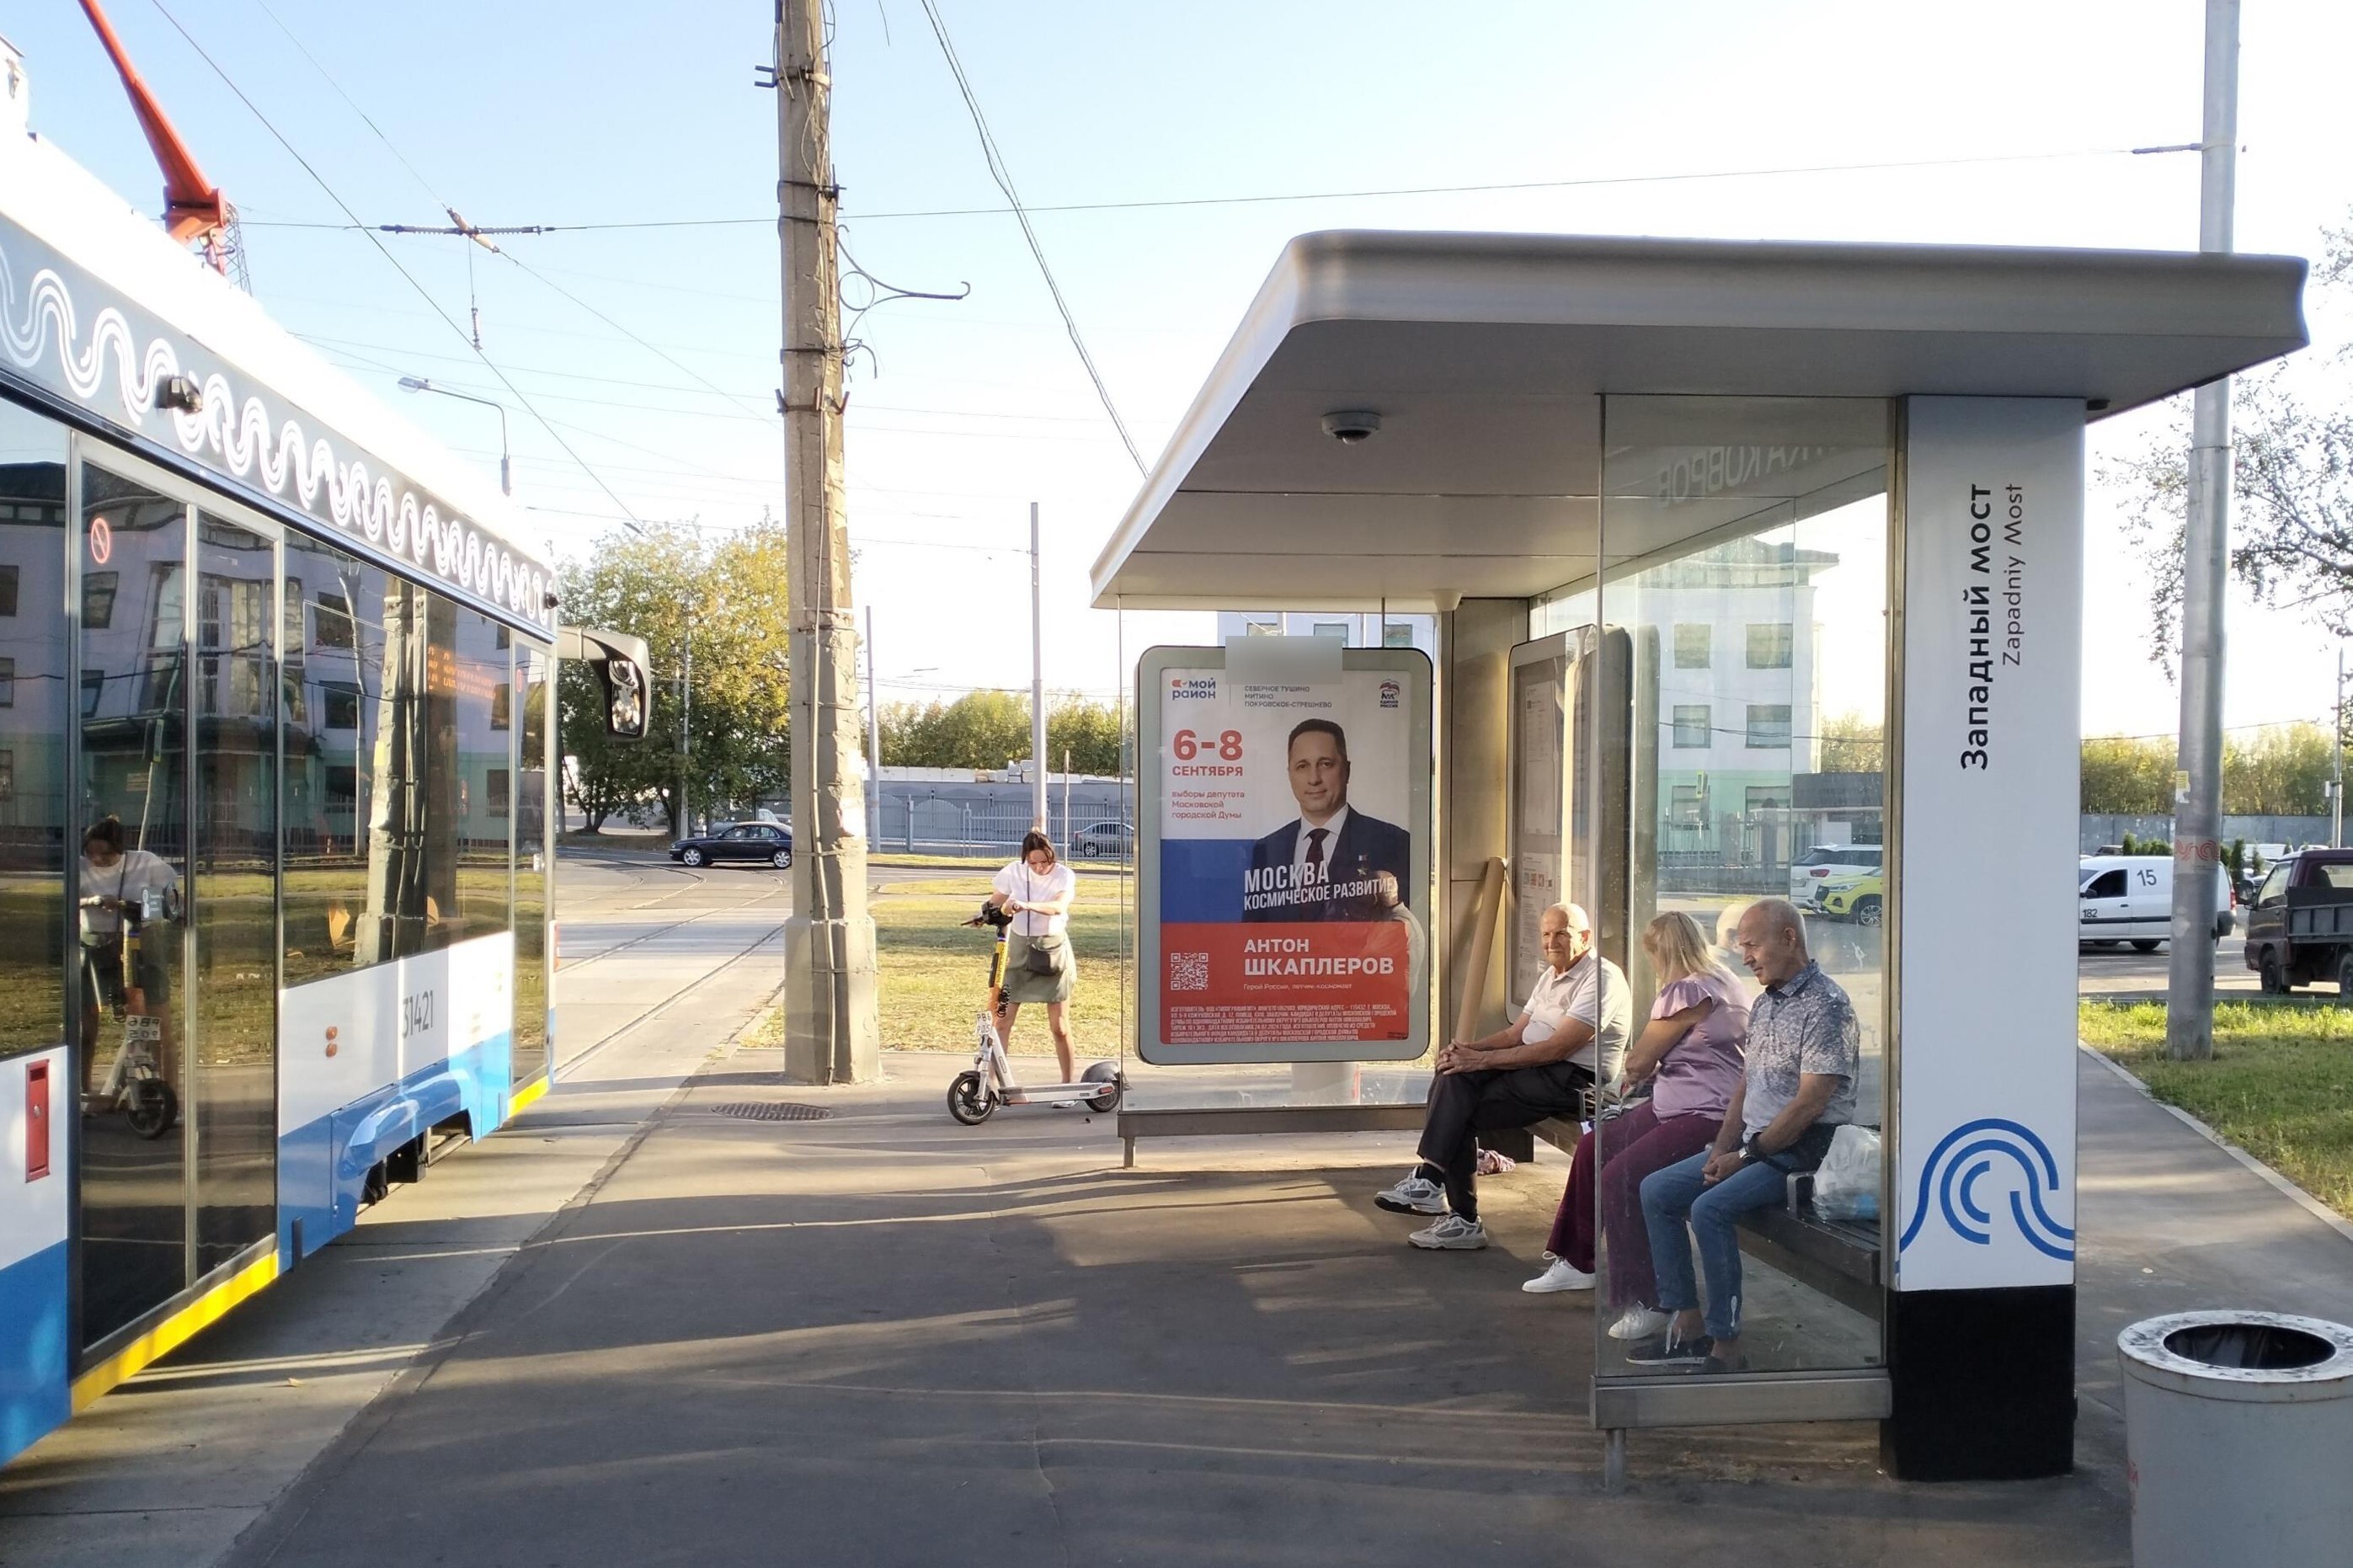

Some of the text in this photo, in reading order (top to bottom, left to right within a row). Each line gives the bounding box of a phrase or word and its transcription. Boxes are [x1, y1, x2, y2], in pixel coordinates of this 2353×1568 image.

[2003, 483, 2025, 666] Zapadniy Most
[1961, 483, 1993, 771] Западный мост
[1172, 765, 1243, 776] СЕНТЯБРЯ
[1171, 790, 1245, 799] выборы депутата
[1171, 800, 1225, 808] Московской
[1171, 811, 1242, 819] городской Думы
[1244, 861, 1329, 893] МОСКВА
[2137, 869, 2157, 887] 15
[1244, 884, 1331, 911] КОСМИЧЕСКОЕ
[2082, 909, 2098, 919] 182
[1243, 938, 1310, 953] АНТОН
[1244, 957, 1395, 976] ШКАПЛЕРОВ
[402, 989, 434, 1040] 31421
